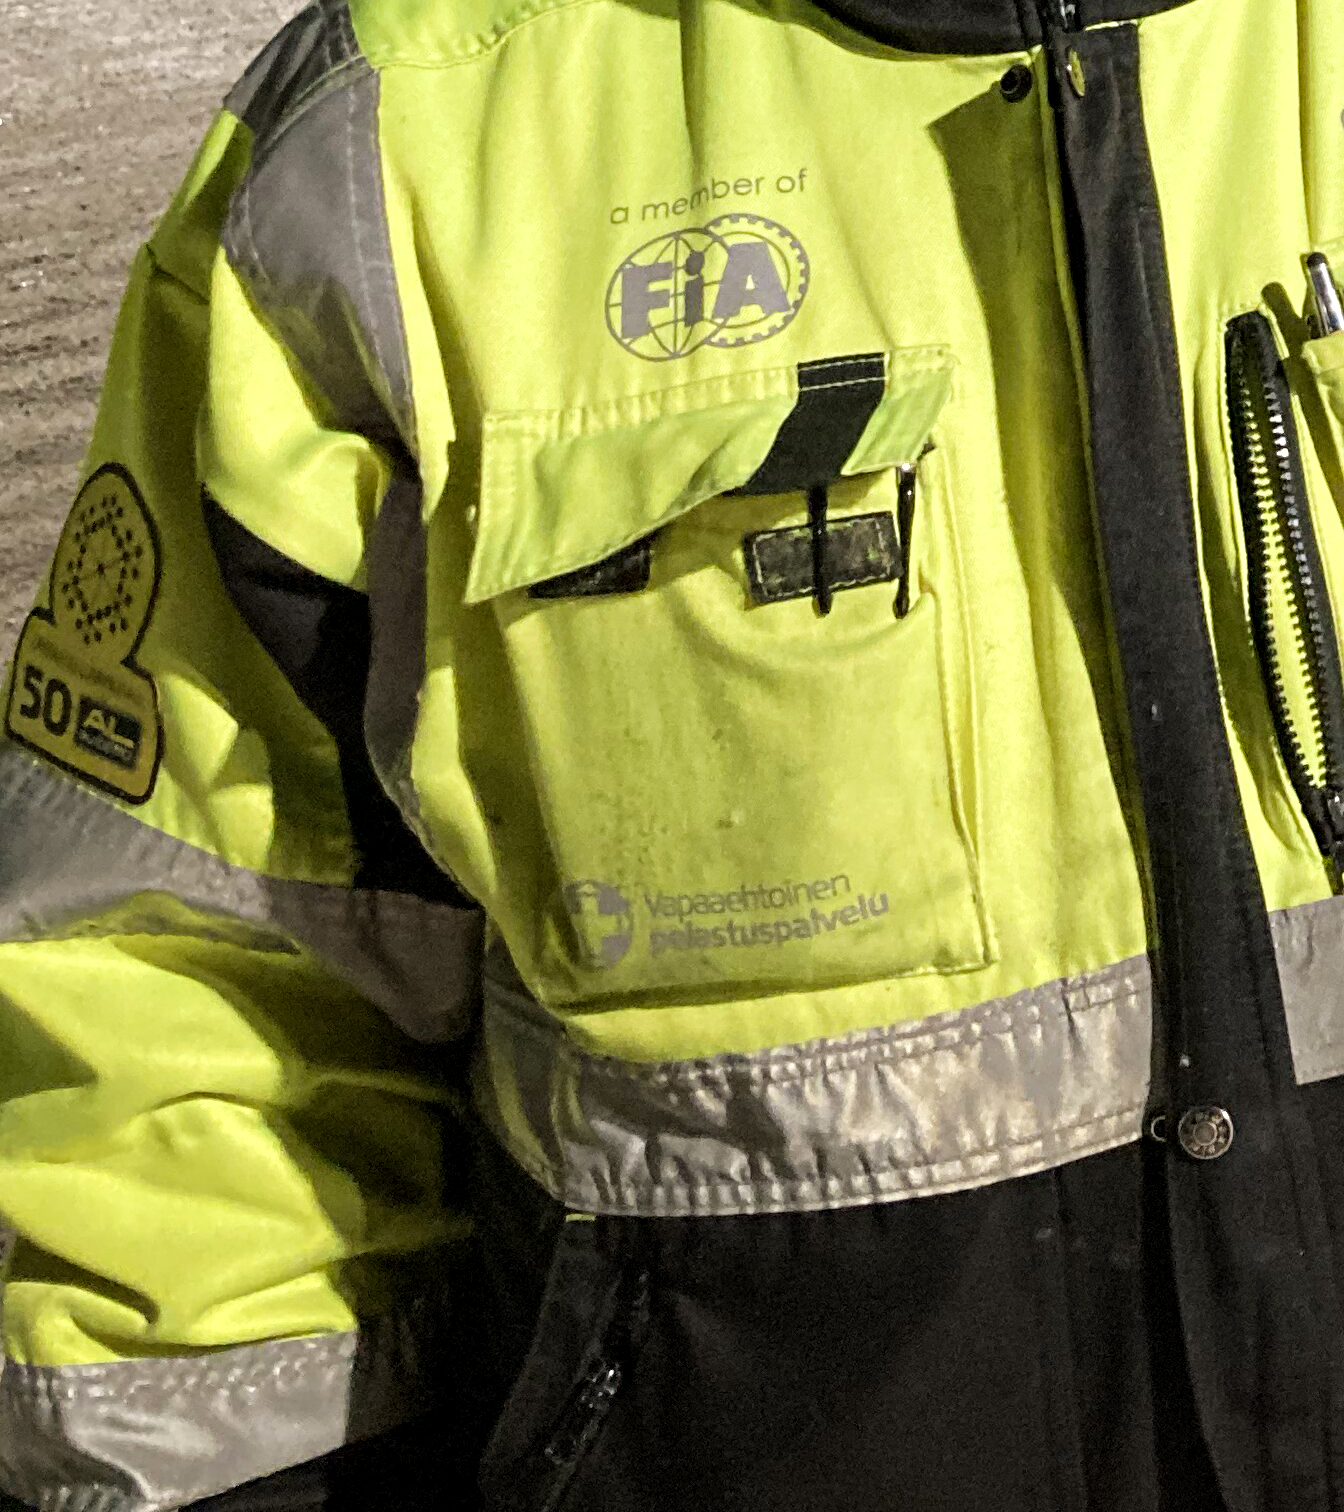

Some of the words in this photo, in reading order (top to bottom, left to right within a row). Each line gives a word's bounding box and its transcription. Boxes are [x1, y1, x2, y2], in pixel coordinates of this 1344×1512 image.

[609, 206, 630, 226] a
[641, 177, 766, 222] member
[775, 168, 808, 194] of
[20, 663, 72, 737] 50
